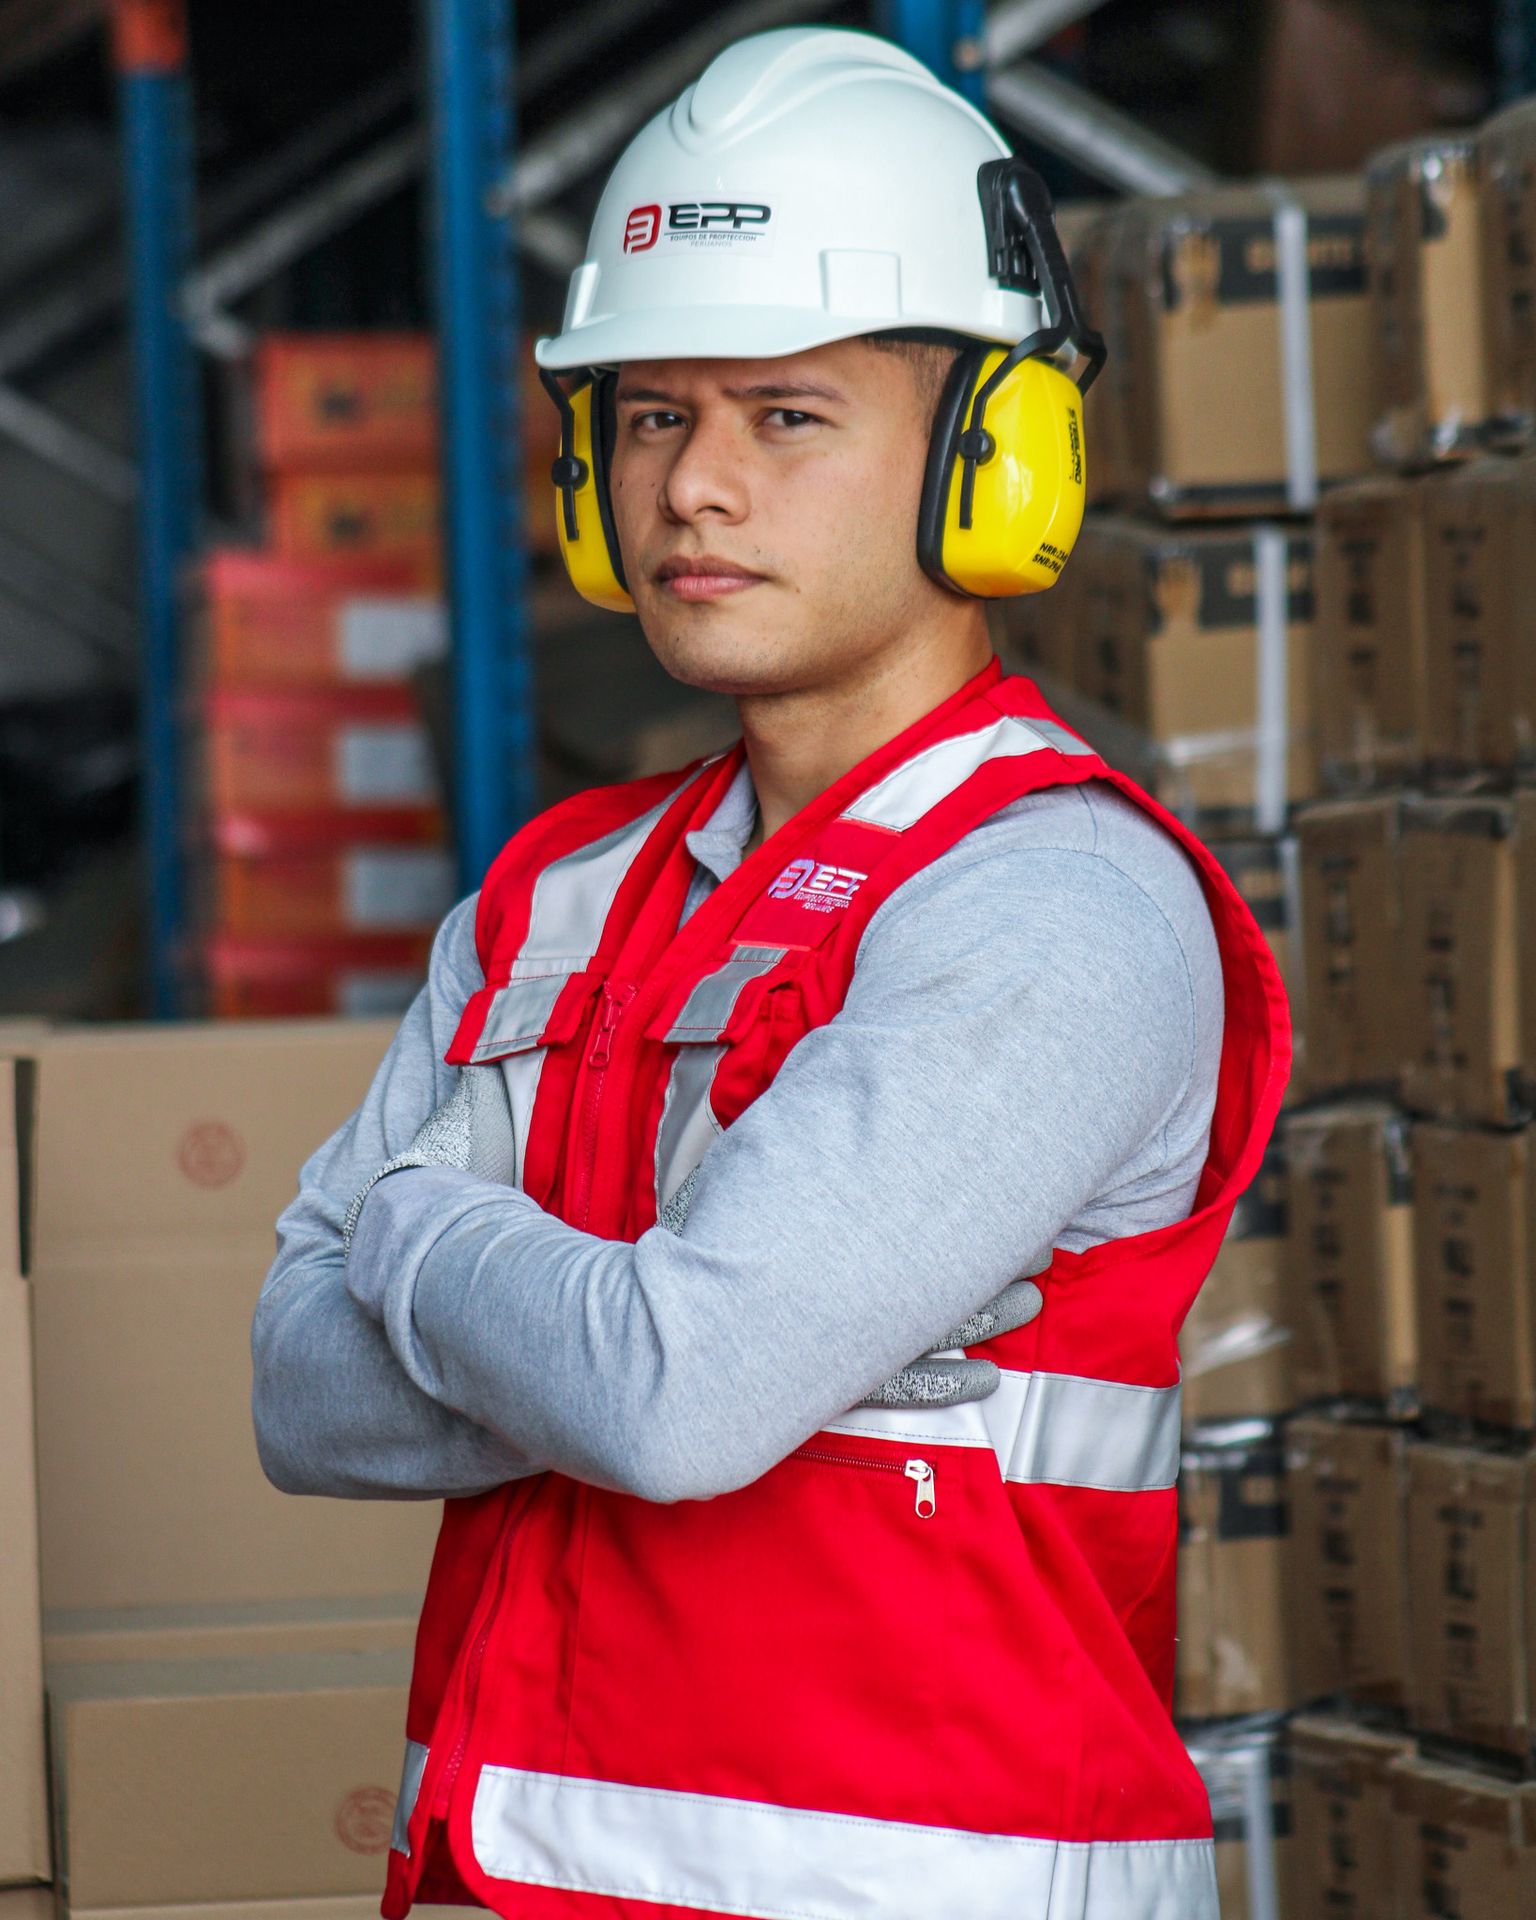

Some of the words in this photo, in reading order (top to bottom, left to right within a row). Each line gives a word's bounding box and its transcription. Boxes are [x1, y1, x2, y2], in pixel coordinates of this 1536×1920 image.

[668, 203, 771, 229] EPP
[670, 233, 698, 242] EQUIPOS
[698, 233, 707, 241] DE
